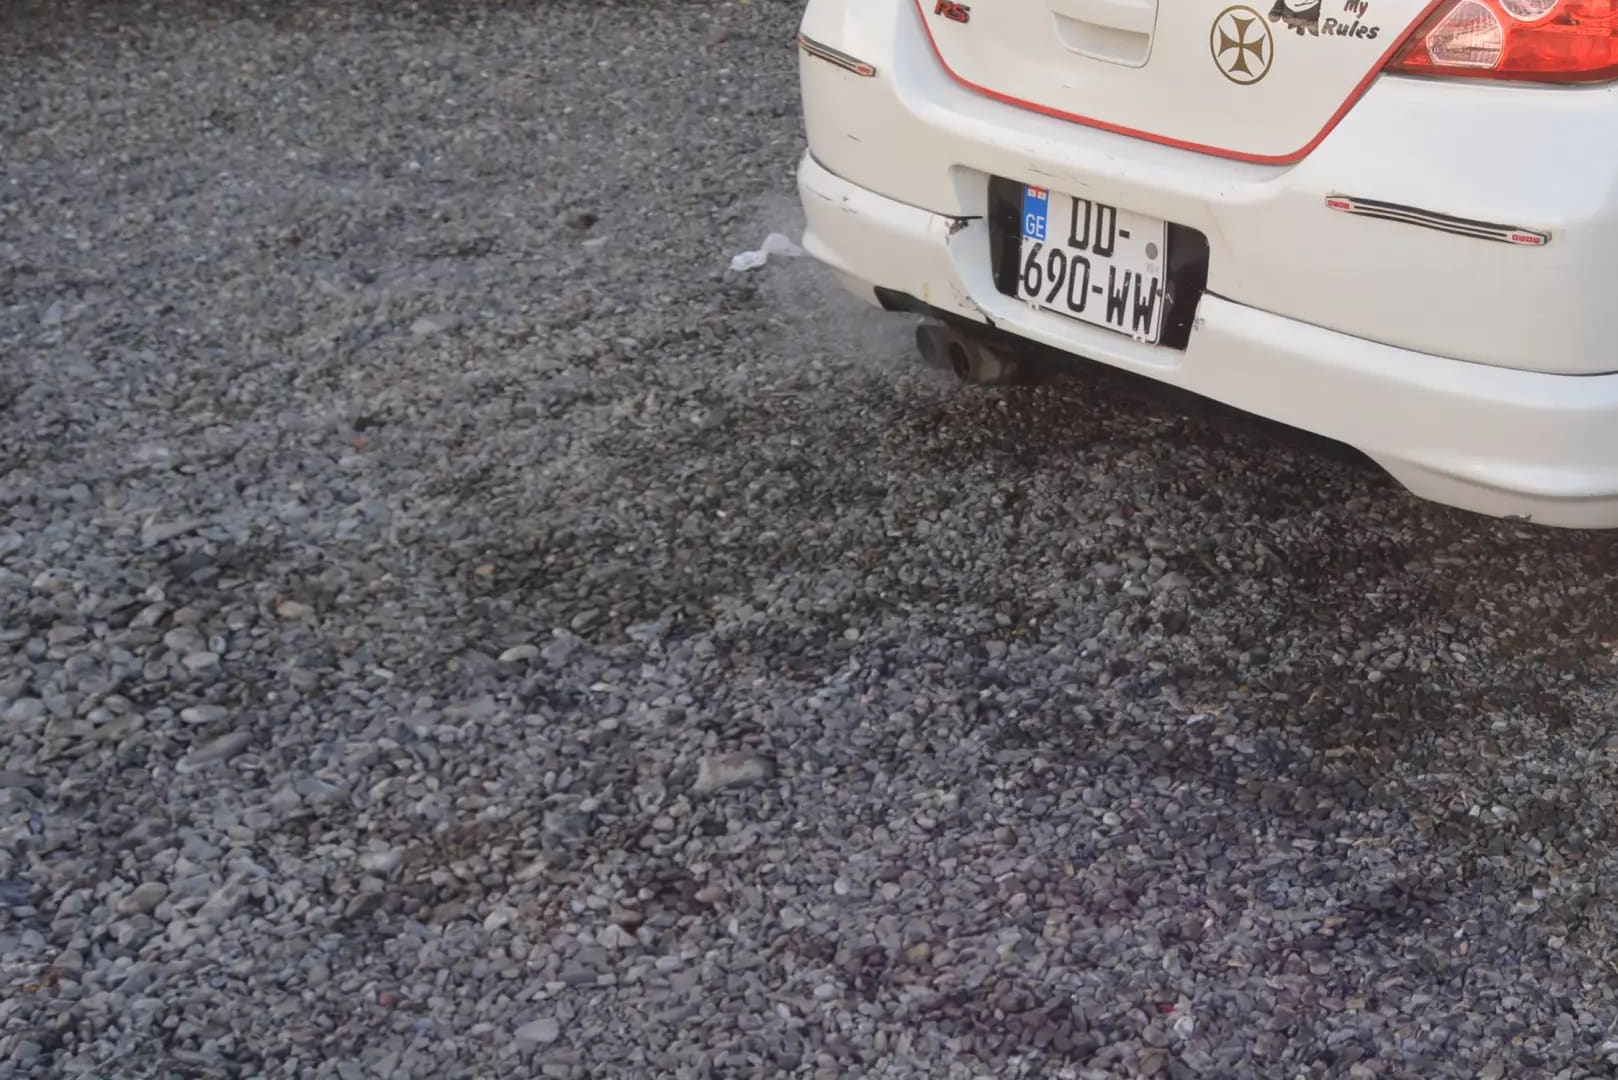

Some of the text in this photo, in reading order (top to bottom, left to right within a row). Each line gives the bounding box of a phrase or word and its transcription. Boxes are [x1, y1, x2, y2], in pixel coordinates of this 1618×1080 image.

[1321, 17, 1380, 39] Rules
[1025, 213, 1045, 238] GE
[1023, 242, 1158, 334] 690-WW
